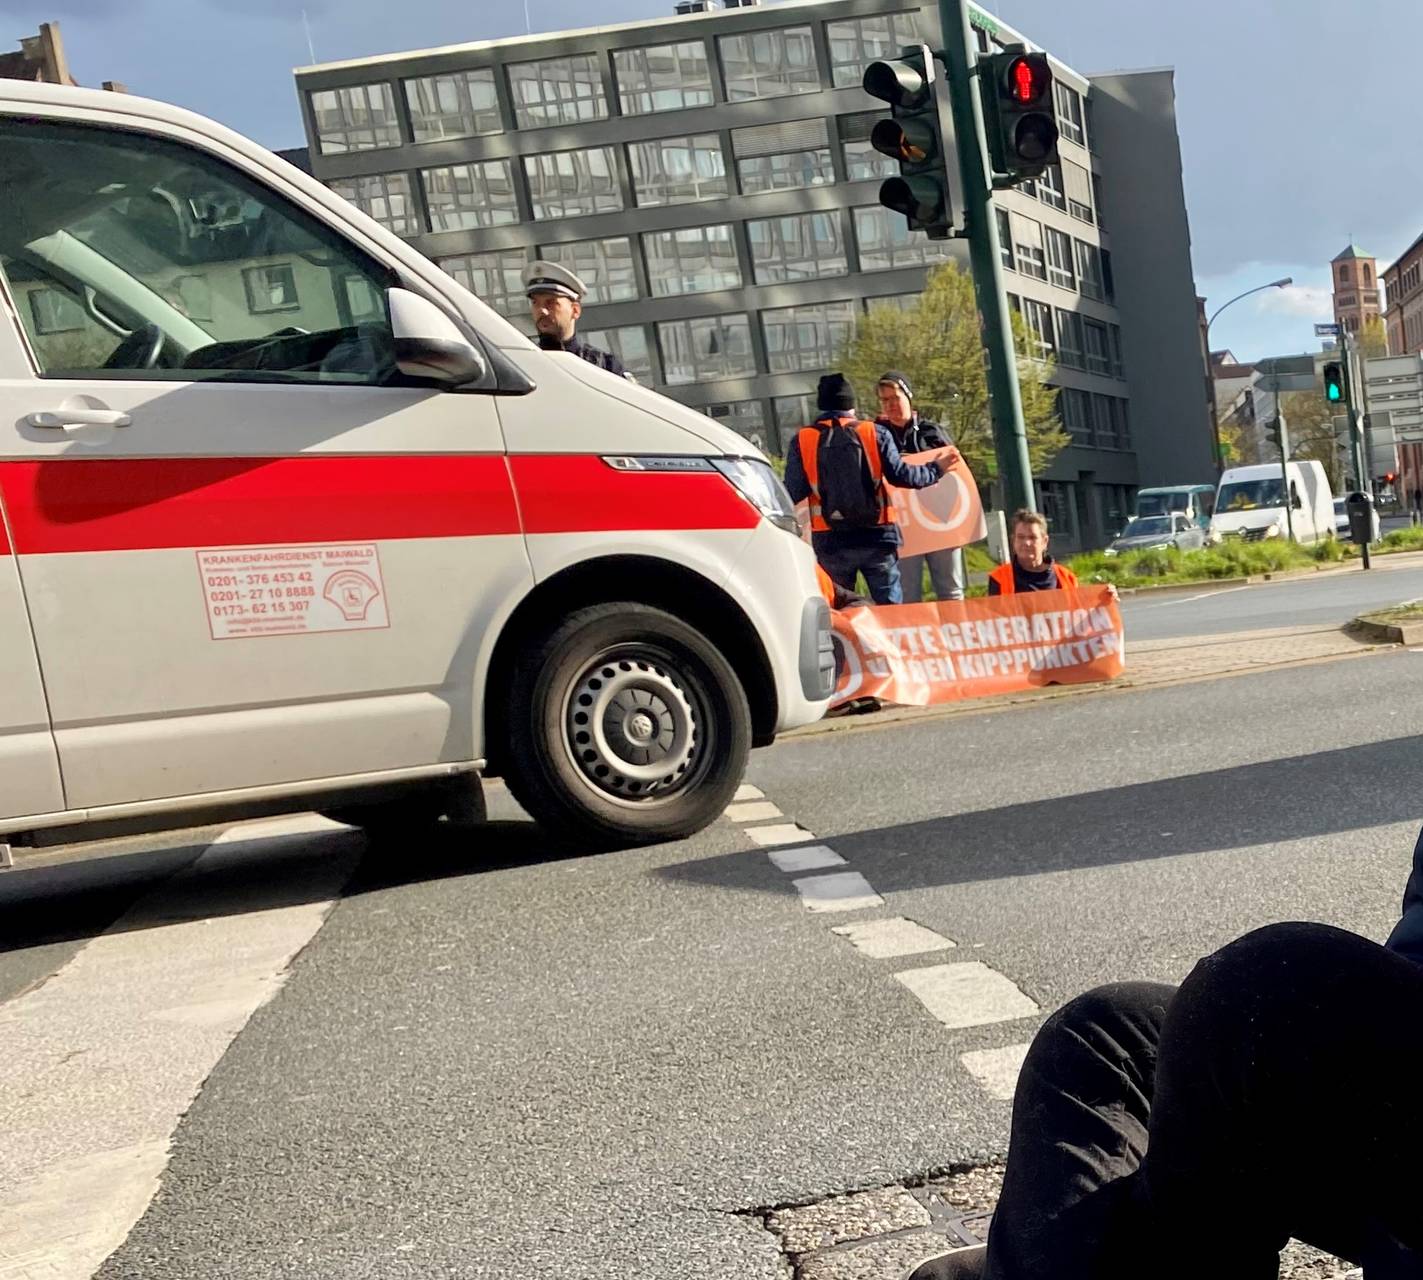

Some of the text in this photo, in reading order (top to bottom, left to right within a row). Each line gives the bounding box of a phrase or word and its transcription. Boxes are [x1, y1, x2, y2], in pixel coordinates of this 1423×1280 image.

[203, 551, 323, 564] KRANKENFAHRDIENST
[208, 571, 313, 587] 0201- 376 453 42
[210, 586, 315, 601] 0201- 27 10 8888
[213, 600, 310, 616] 0173- 62 15 307
[941, 606, 1114, 651] GENERATION
[959, 632, 1121, 679] KIPPPUNKTEN
